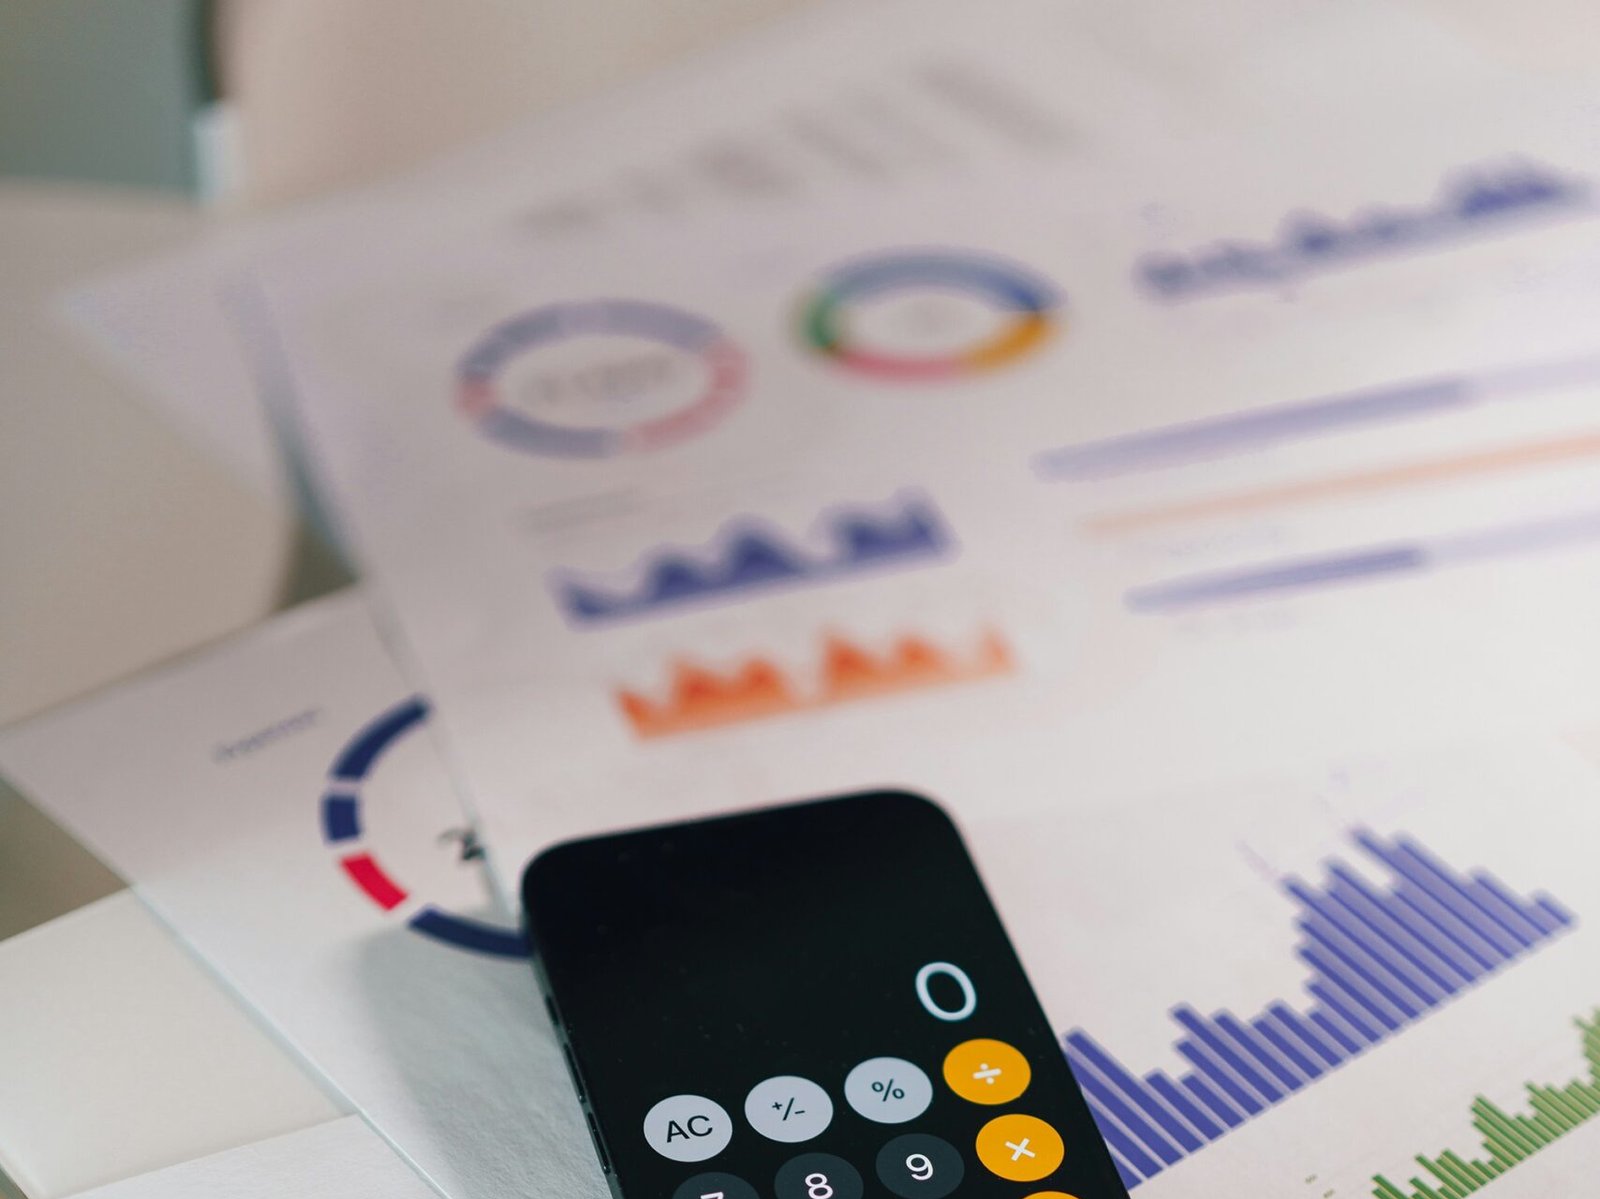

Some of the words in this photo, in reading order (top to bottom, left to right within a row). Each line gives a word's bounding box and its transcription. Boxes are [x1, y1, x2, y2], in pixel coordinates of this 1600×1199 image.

[915, 961, 977, 1022] 0
[665, 1114, 714, 1144] AC
[870, 1078, 906, 1103] %
[905, 1153, 934, 1181] 9
